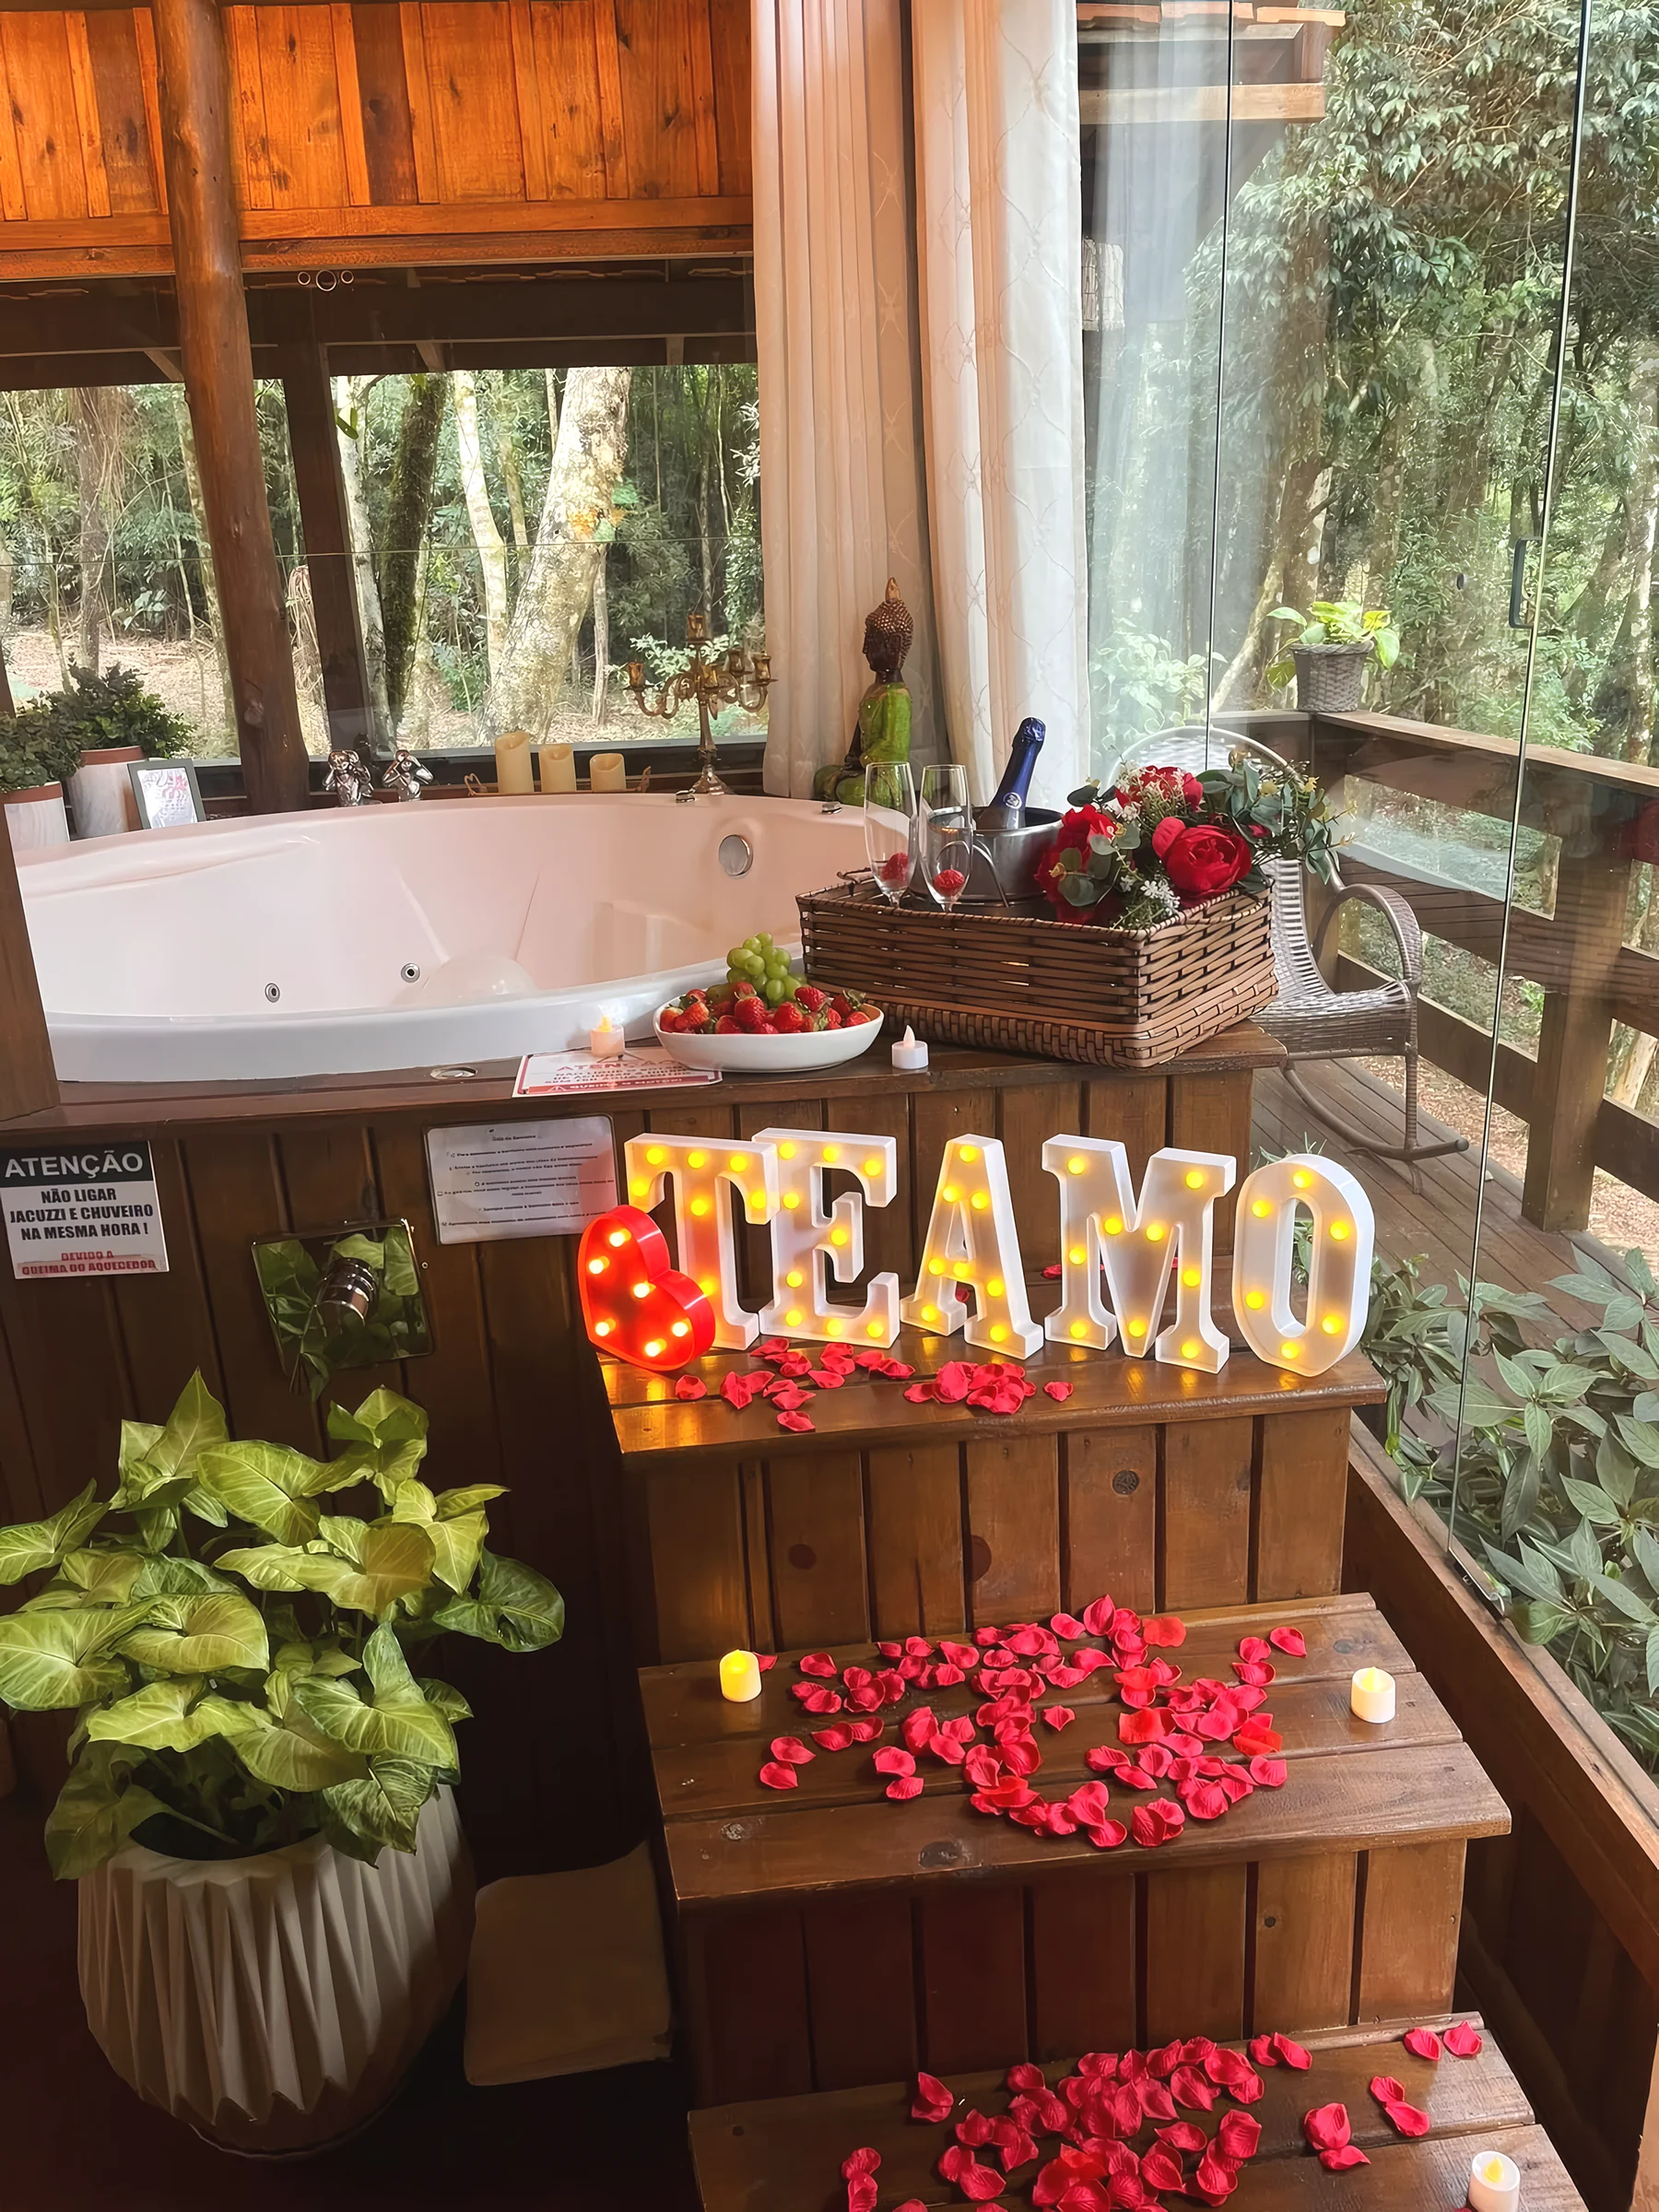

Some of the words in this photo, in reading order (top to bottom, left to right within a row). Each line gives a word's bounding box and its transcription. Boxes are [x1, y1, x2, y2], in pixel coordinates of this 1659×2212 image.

[5, 1150, 143, 1179] ATENÇÃO
[41, 1188, 71, 1204] NÃO
[75, 1188, 117, 1202] LIGAR
[10, 1208, 66, 1223] JACUZZI
[70, 1207, 78, 1220] E
[81, 1204, 153, 1220] CHUVEIRO
[21, 1228, 41, 1241] NA
[44, 1225, 99, 1240] MESMA
[100, 1223, 141, 1237] HORA
[61, 1252, 103, 1262] DEVIDO
[106, 1251, 114, 1259] A
[22, 1265, 68, 1276] QUEIMA
[70, 1263, 86, 1273] DO
